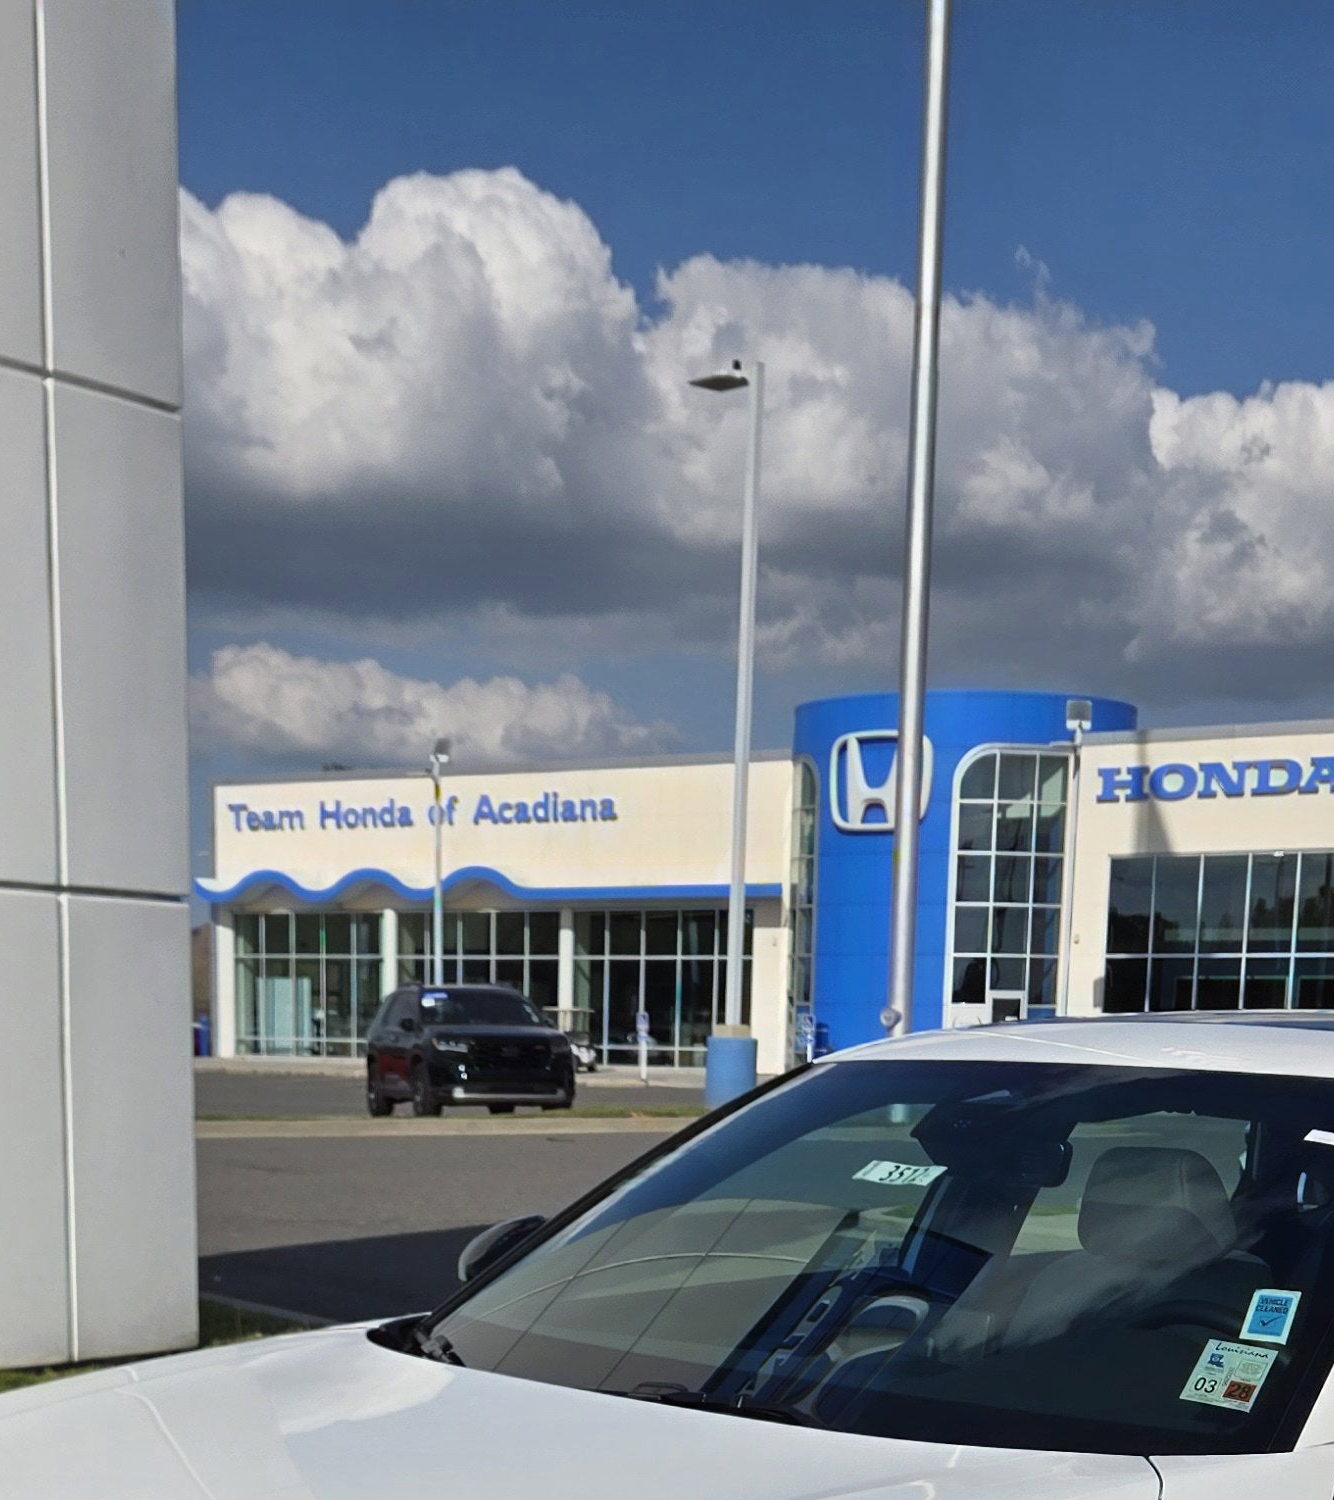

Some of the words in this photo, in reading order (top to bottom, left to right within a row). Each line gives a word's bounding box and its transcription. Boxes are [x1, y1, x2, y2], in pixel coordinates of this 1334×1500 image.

[227, 803, 305, 832] Team
[319, 798, 414, 830] Honda
[428, 795, 459, 827] of
[472, 791, 618, 826] Acadiana
[1215, 1342, 1269, 1359] Louisiana
[1194, 1377, 1217, 1393] 03
[1229, 1383, 1252, 1399] 28
